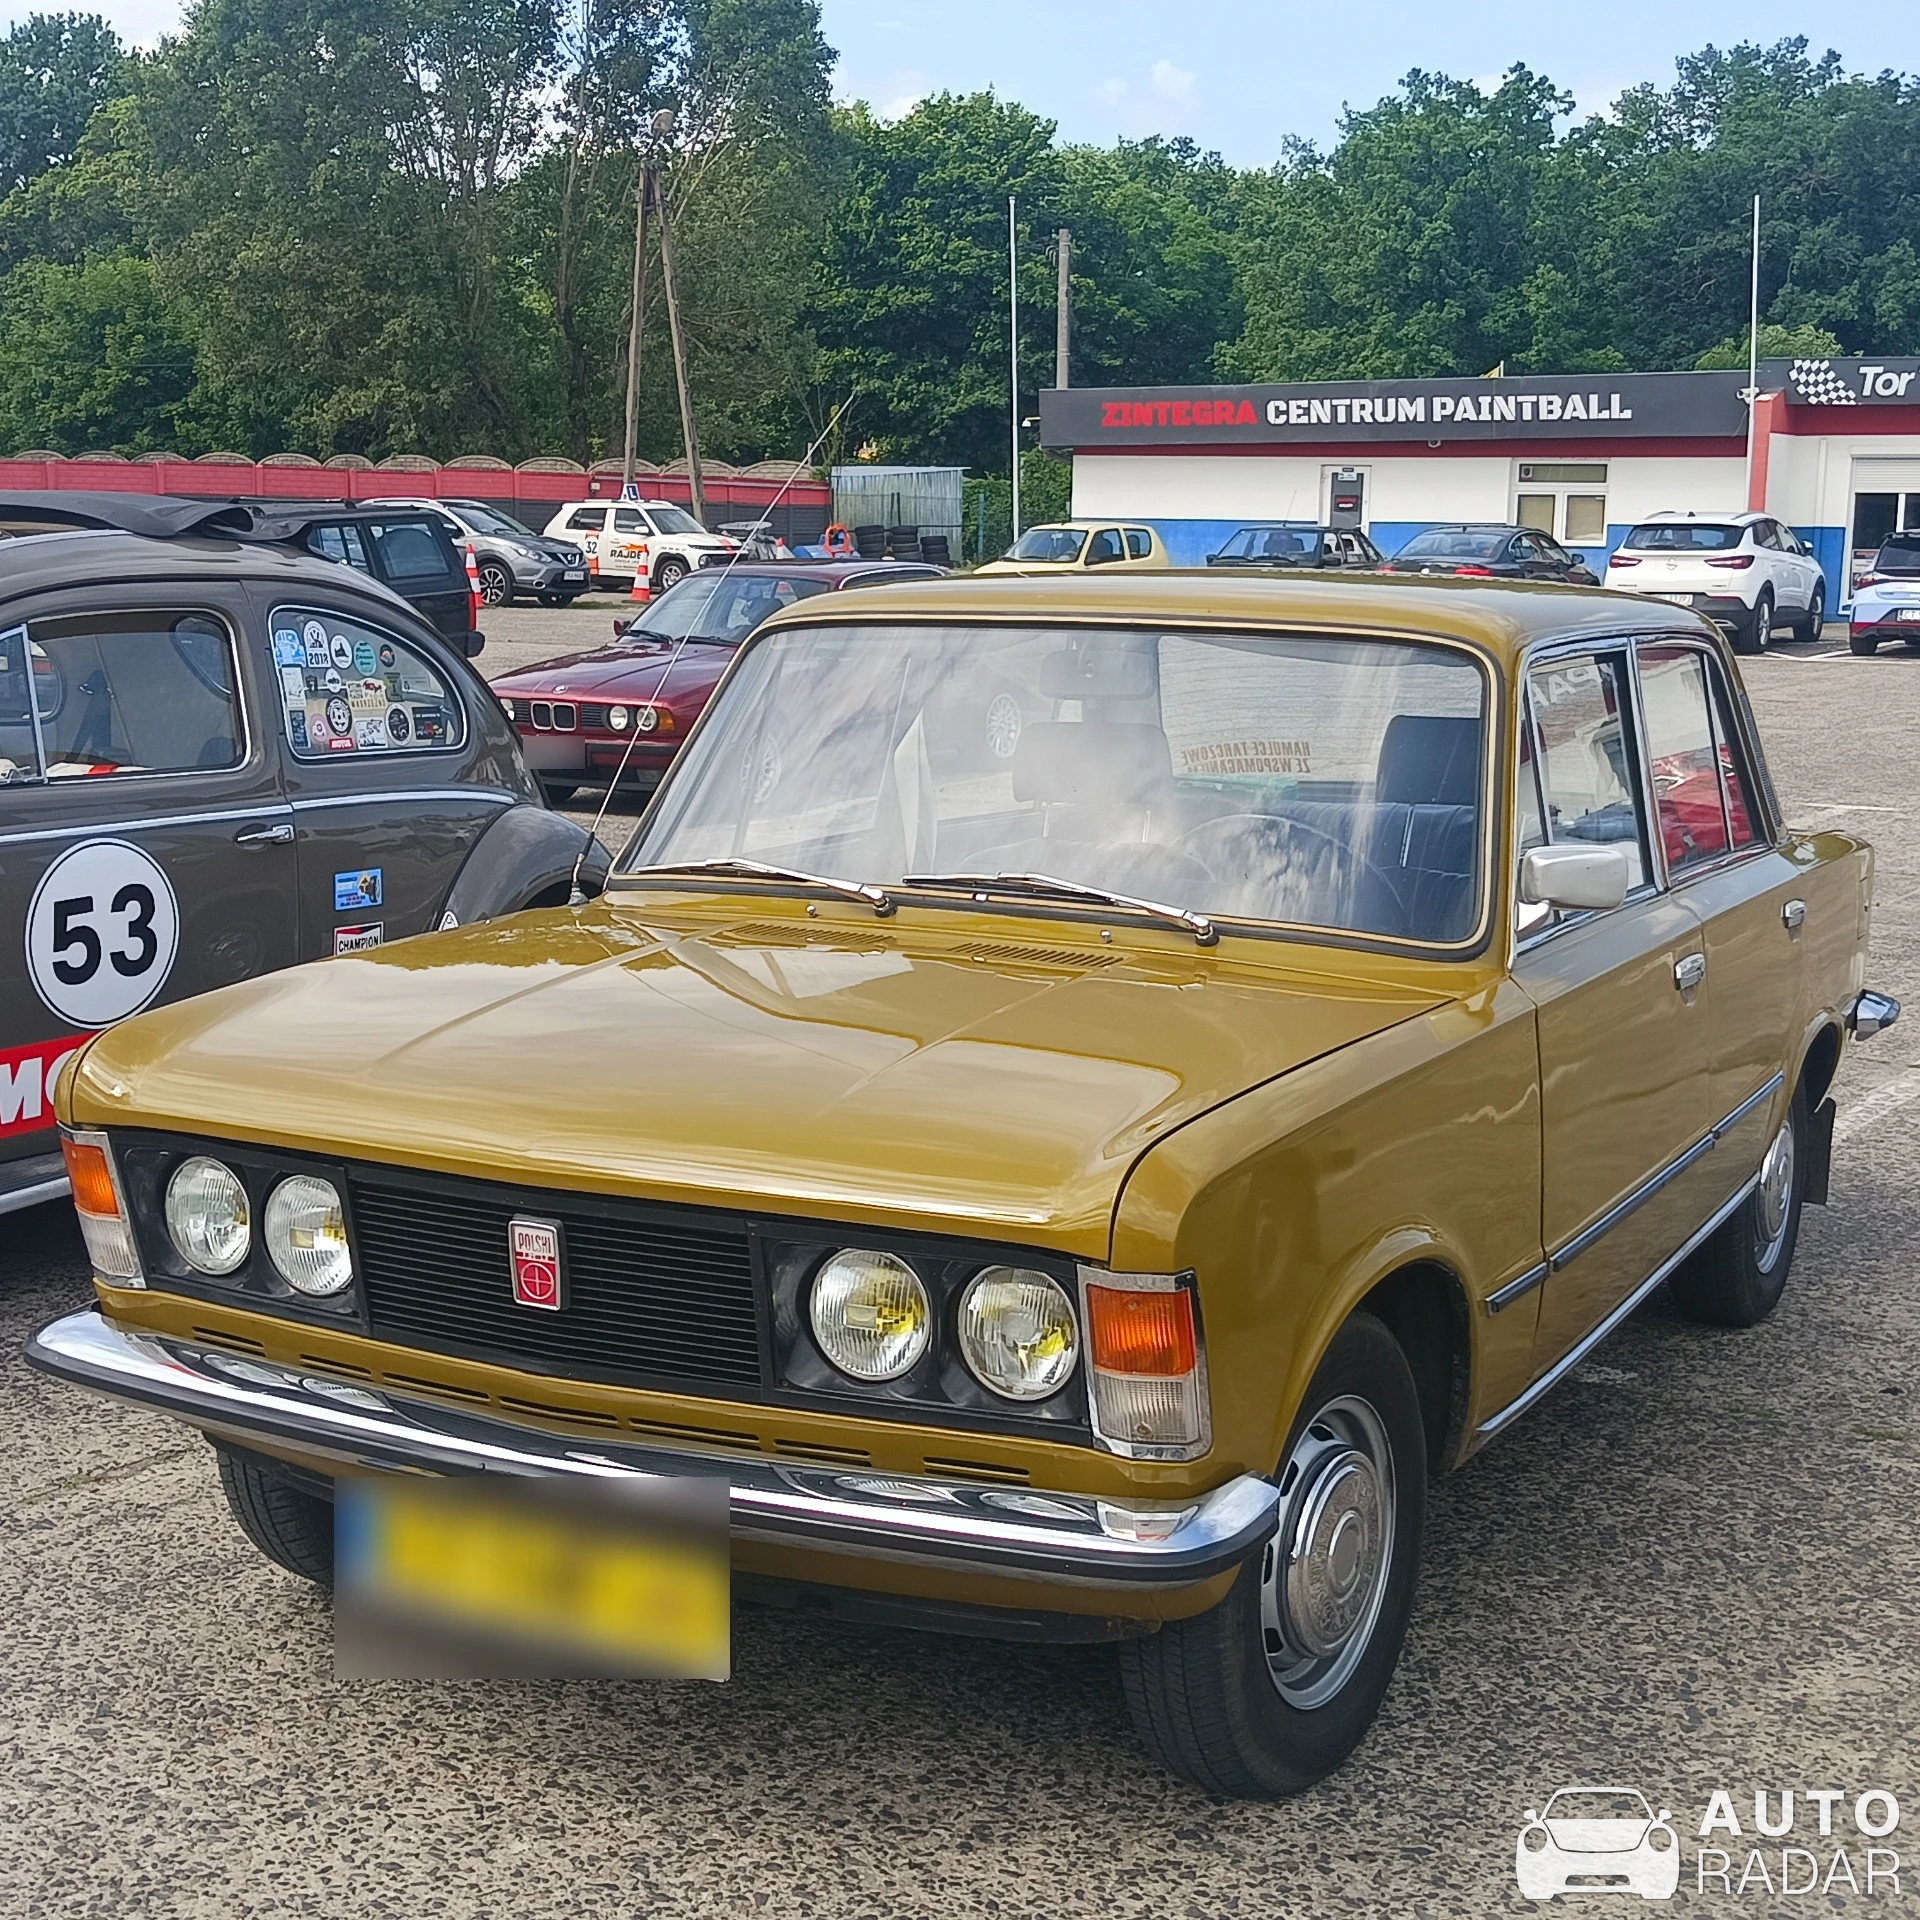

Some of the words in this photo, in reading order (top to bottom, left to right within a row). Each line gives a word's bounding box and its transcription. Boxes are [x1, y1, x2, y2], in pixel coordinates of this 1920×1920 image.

[1858, 365, 1916, 397] Tor
[1101, 399, 1258, 427] ZINTEGRA
[1265, 396, 1426, 426] CENTRUM
[1431, 393, 1633, 422] PAINTBALL
[628, 487, 637, 498] L
[585, 540, 598, 554] 32
[52, 883, 158, 985] 53
[338, 935, 379, 953] CHAMPION
